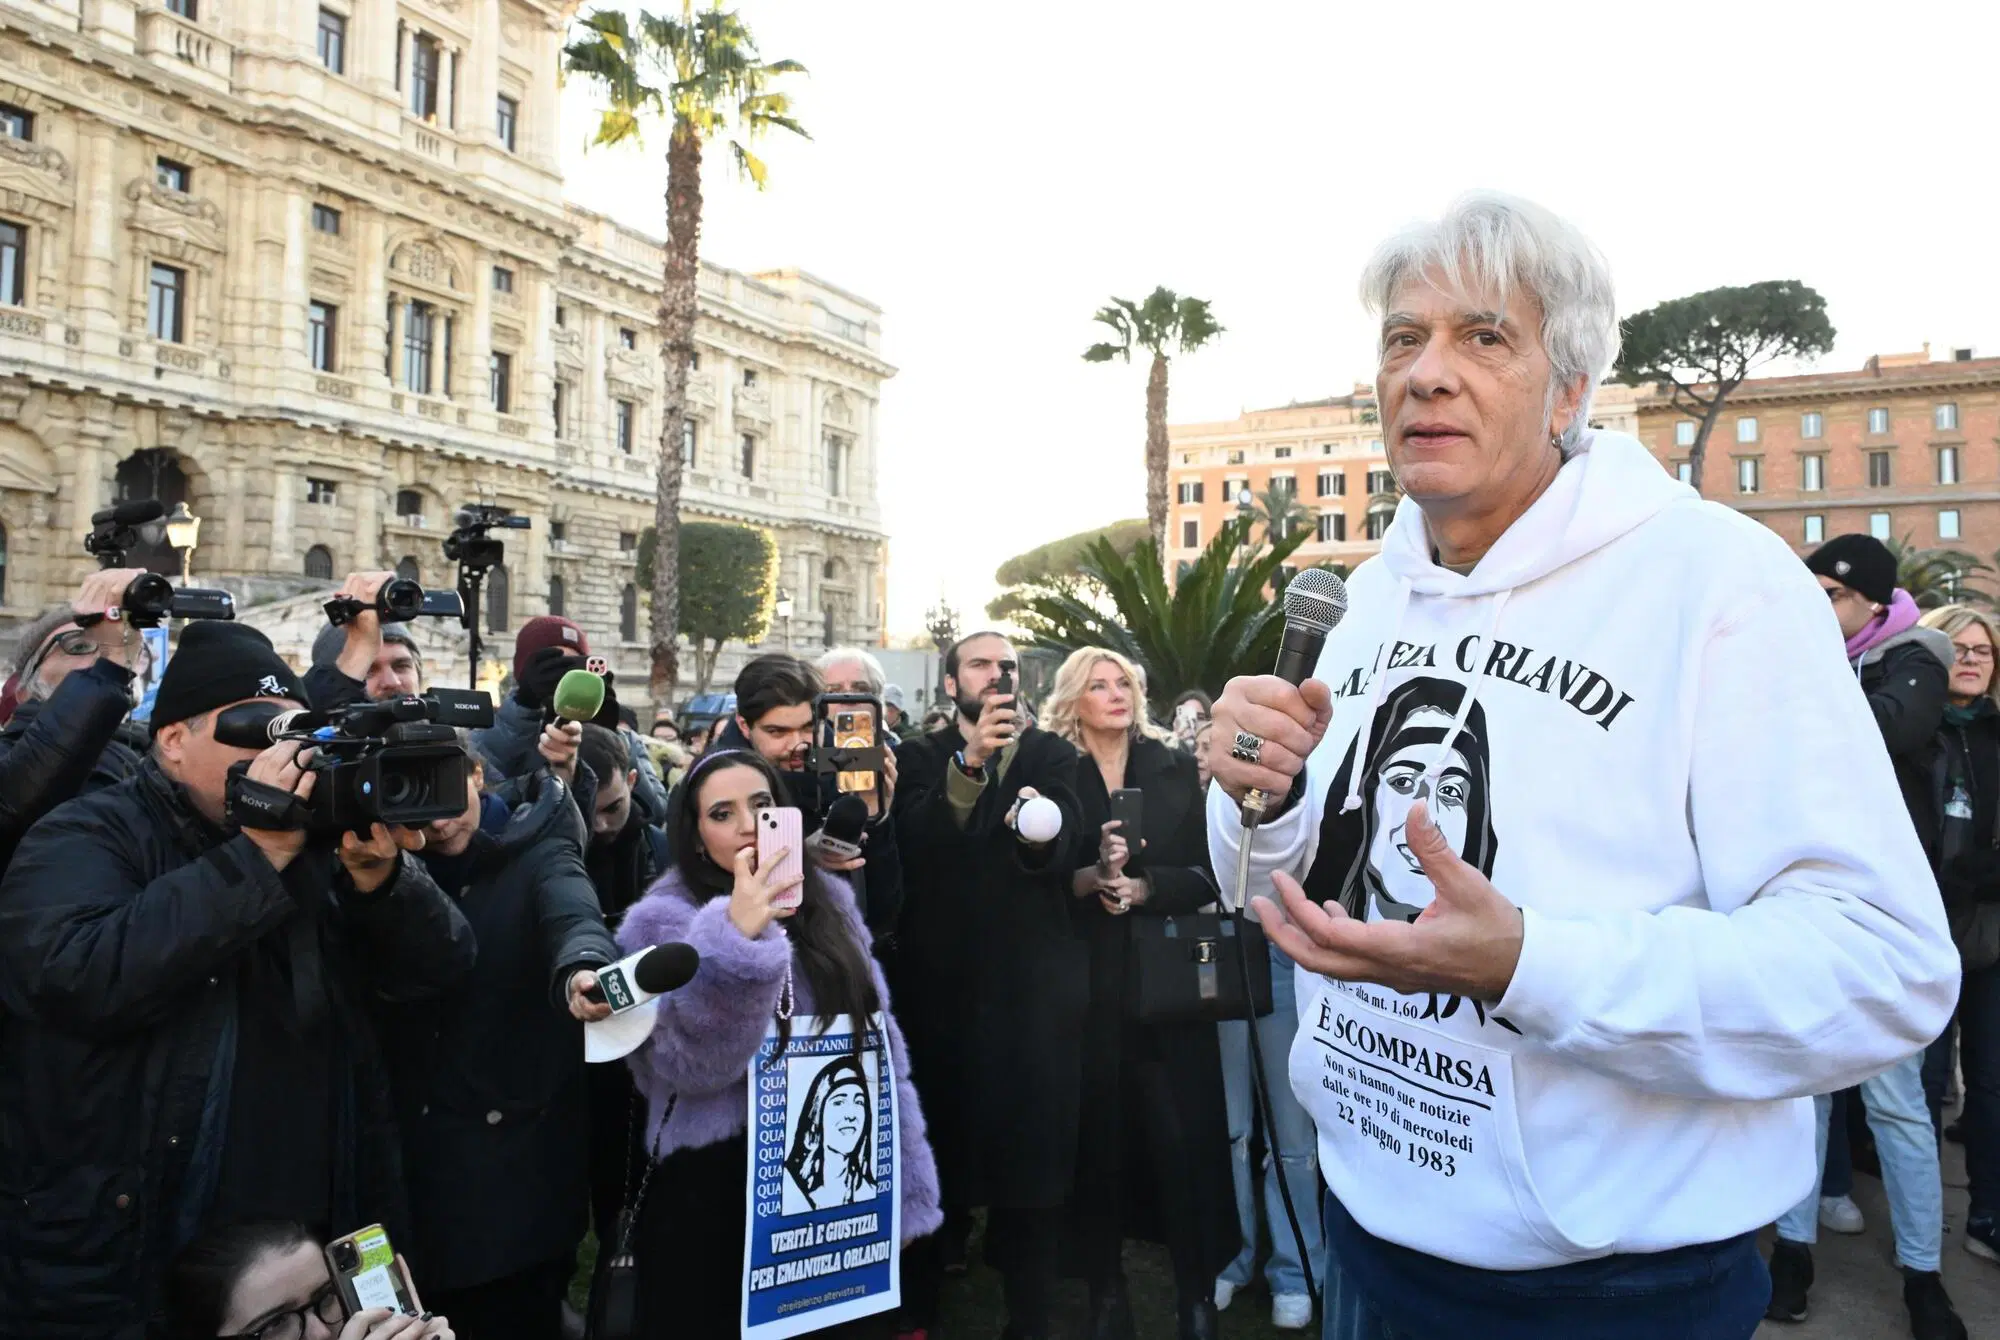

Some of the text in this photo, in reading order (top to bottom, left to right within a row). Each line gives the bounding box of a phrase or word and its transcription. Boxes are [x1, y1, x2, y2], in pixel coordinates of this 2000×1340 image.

[1455, 634, 1635, 732] ORLANDI
[240, 794, 272, 811] SONY
[608, 972, 630, 1006] tg3
[1355, 985, 1370, 1003] alta
[1371, 996, 1388, 1011] mt.
[1392, 999, 1418, 1019] 1,60
[760, 1038, 849, 1056] QURANT'ANNI
[1317, 997, 1496, 1097] È SCOMPARSA
[1322, 1075, 1350, 1098] dalle
[1353, 1091, 1372, 1109] ore
[1375, 1099, 1388, 1118] 19
[1390, 1107, 1400, 1125] di
[1323, 1053, 1471, 1127] Non si hanno sue notizie
[1336, 1101, 1456, 1178] 22 giugno 1983
[771, 1213, 878, 1254] VERITÀ E GIUSTIZIA
[750, 1240, 891, 1291] PER EMANUELA ORLANDI
